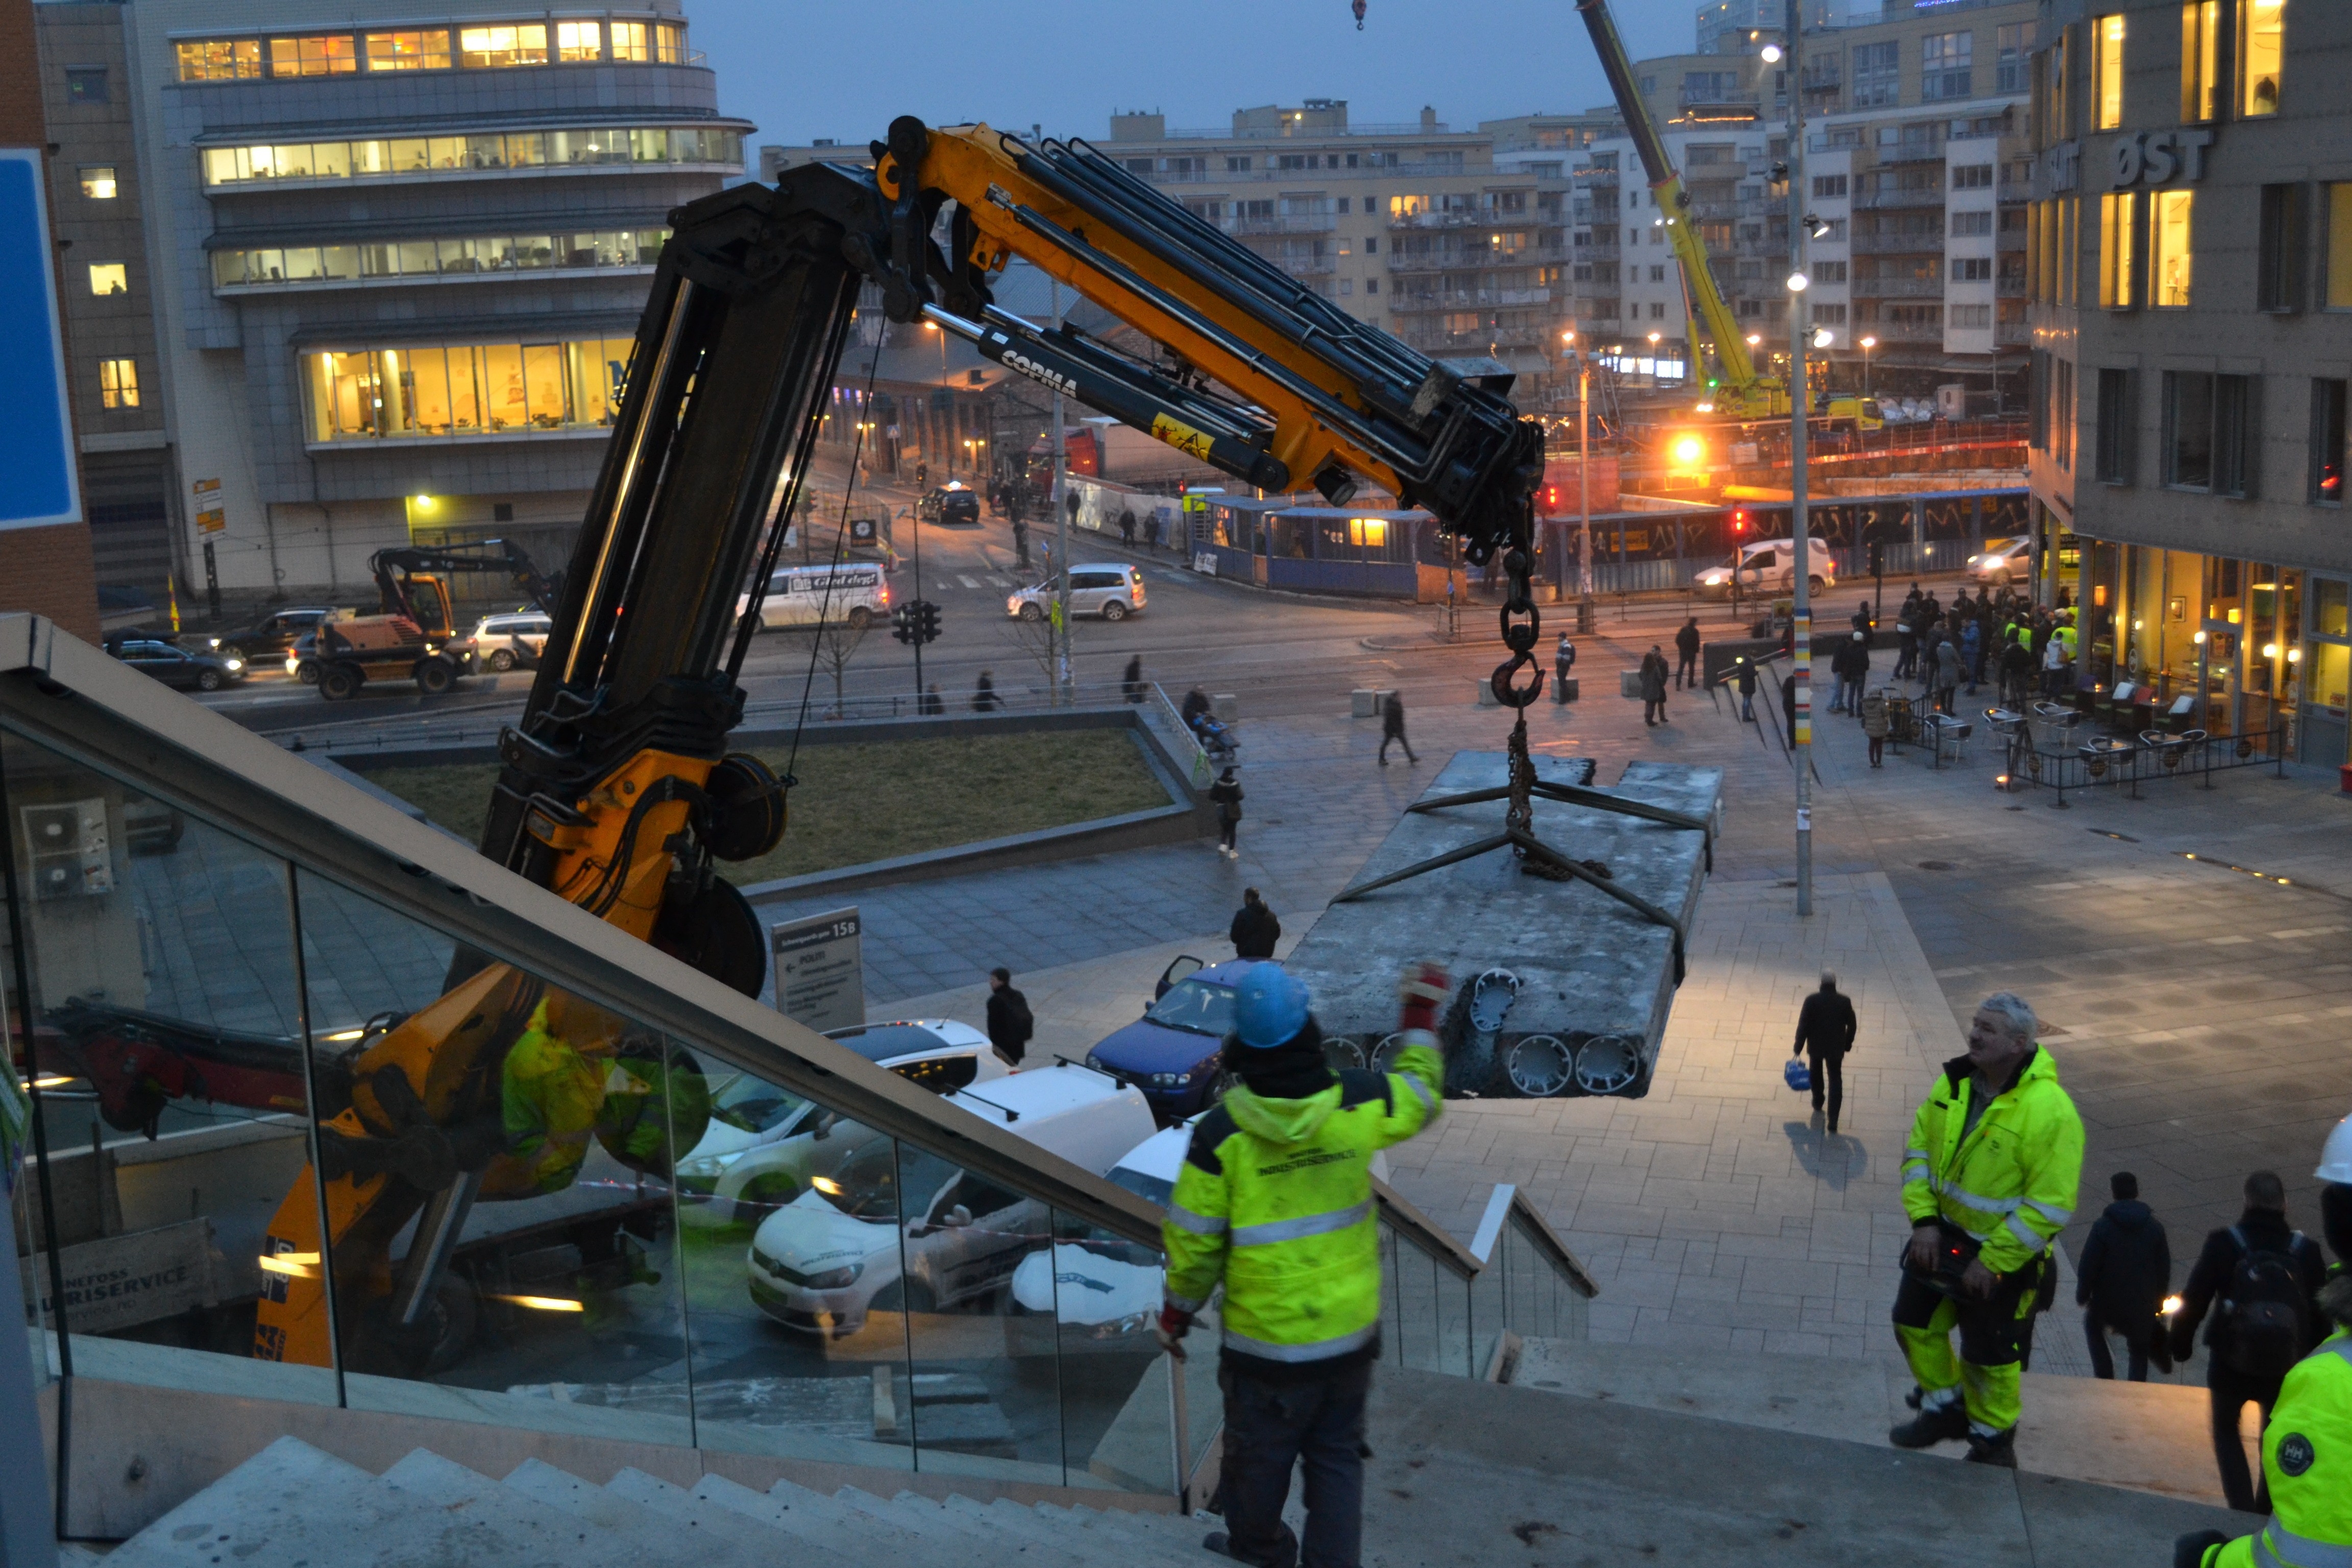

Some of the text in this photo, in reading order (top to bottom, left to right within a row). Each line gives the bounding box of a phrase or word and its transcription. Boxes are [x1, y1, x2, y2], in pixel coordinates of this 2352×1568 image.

[2112, 130, 2214, 191] ØST
[1001, 350, 1077, 399] COPMA
[832, 921, 856, 937] 15B
